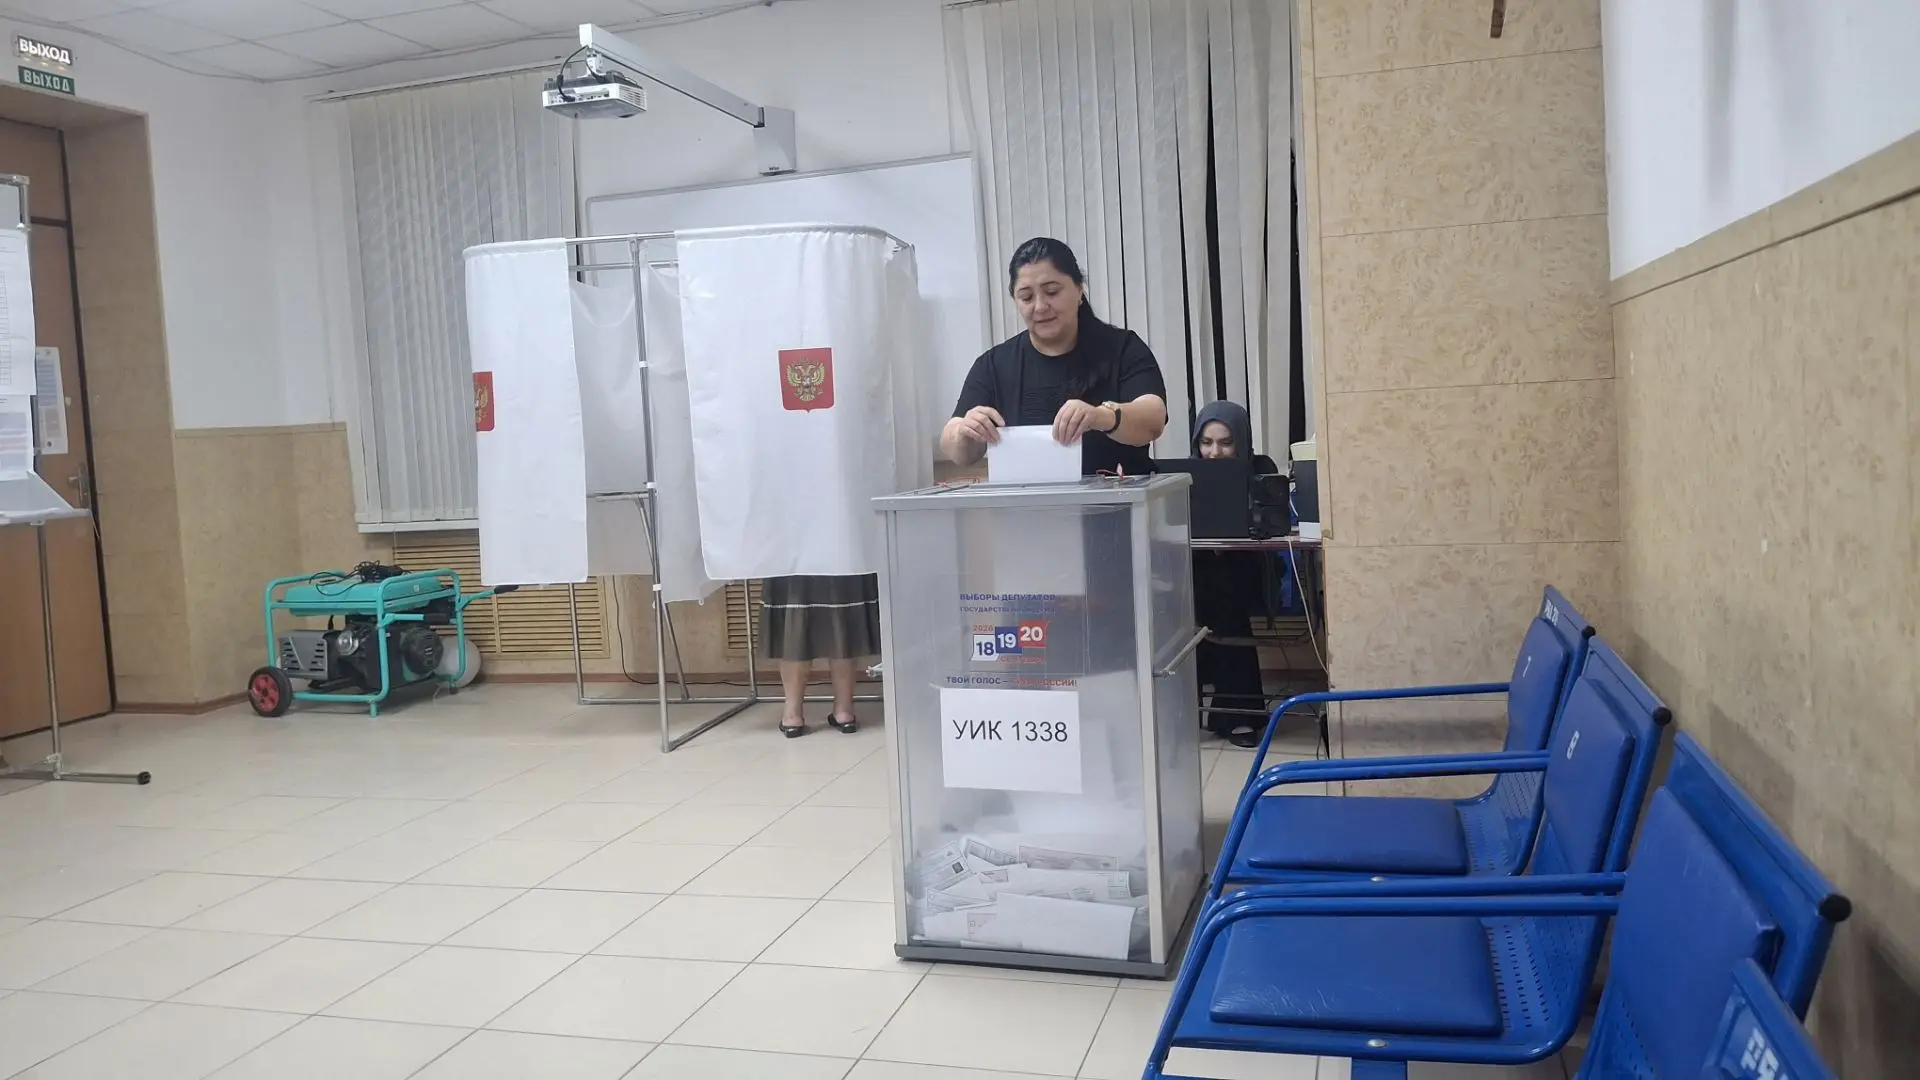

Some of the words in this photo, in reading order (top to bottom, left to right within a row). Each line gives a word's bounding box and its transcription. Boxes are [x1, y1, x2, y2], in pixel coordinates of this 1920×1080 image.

[19, 38, 71, 64] ВЫХОД
[23, 69, 70, 92] ВЫХОД
[960, 593, 1000, 601] ВЫБОРЫ
[973, 624, 994, 632] 2026
[976, 641, 995, 656] 18
[997, 633, 1017, 649] 19
[1020, 626, 1044, 642] 20
[971, 677, 1001, 685] ГОЛОС
[952, 719, 1002, 740] УИК
[1011, 721, 1068, 742] 1338
